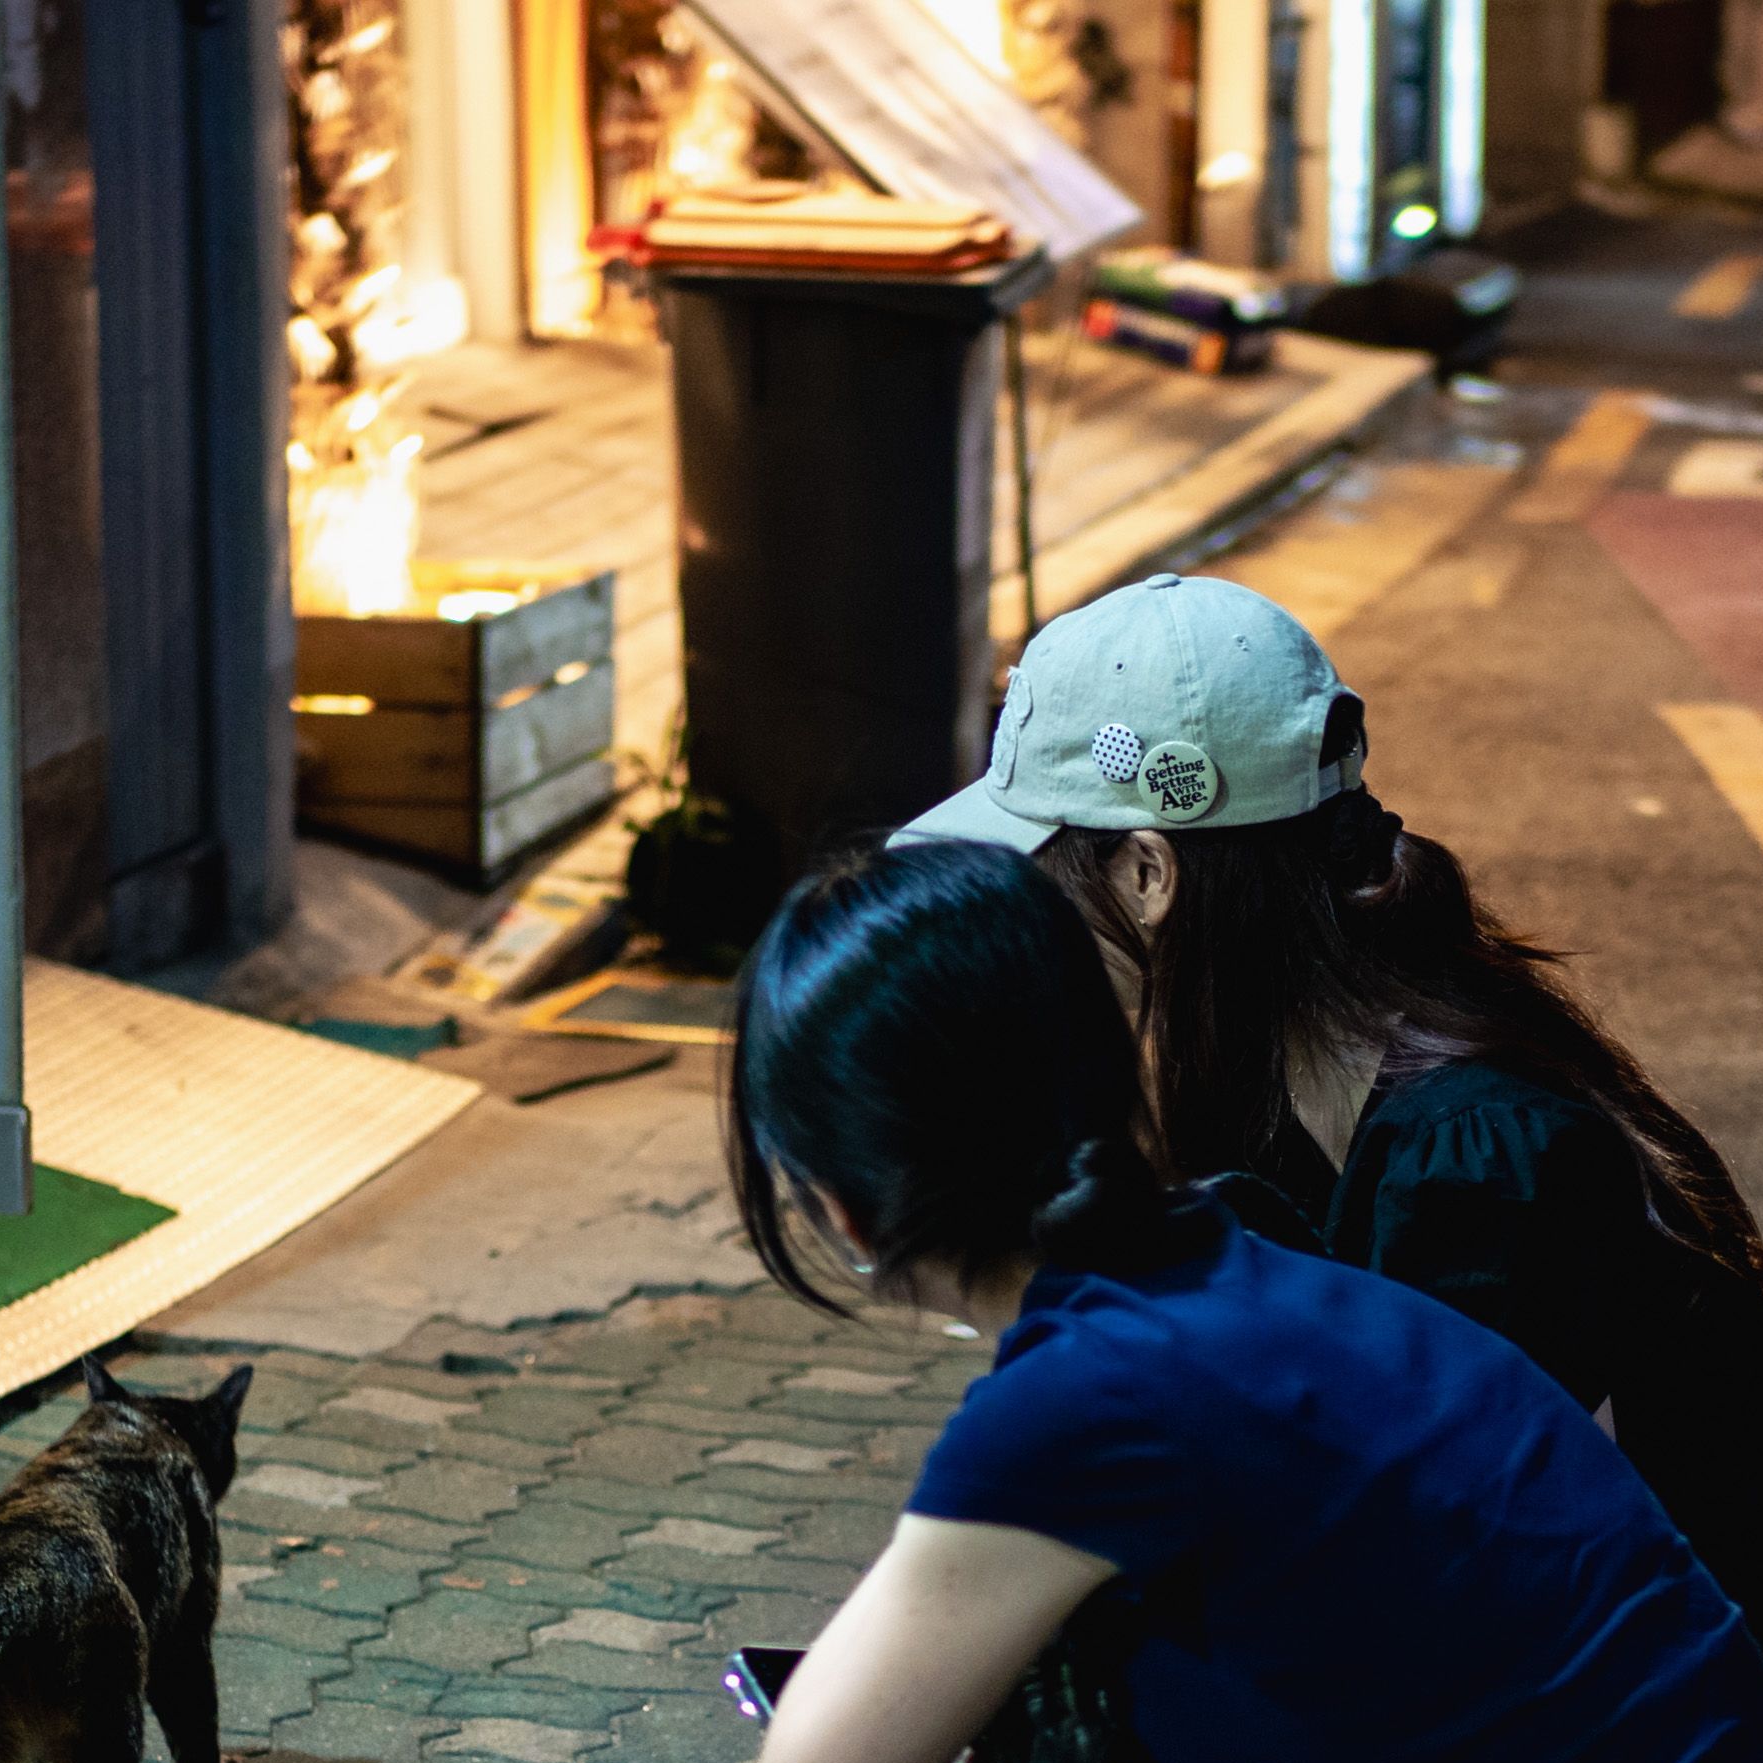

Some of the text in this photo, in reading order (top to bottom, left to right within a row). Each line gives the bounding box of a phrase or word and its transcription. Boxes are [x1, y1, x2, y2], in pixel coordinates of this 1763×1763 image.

[1145, 759, 1205, 781] Getting
[1148, 774, 1198, 793] Better
[1172, 781, 1207, 796] WITH
[1160, 790, 1208, 812] Age.
